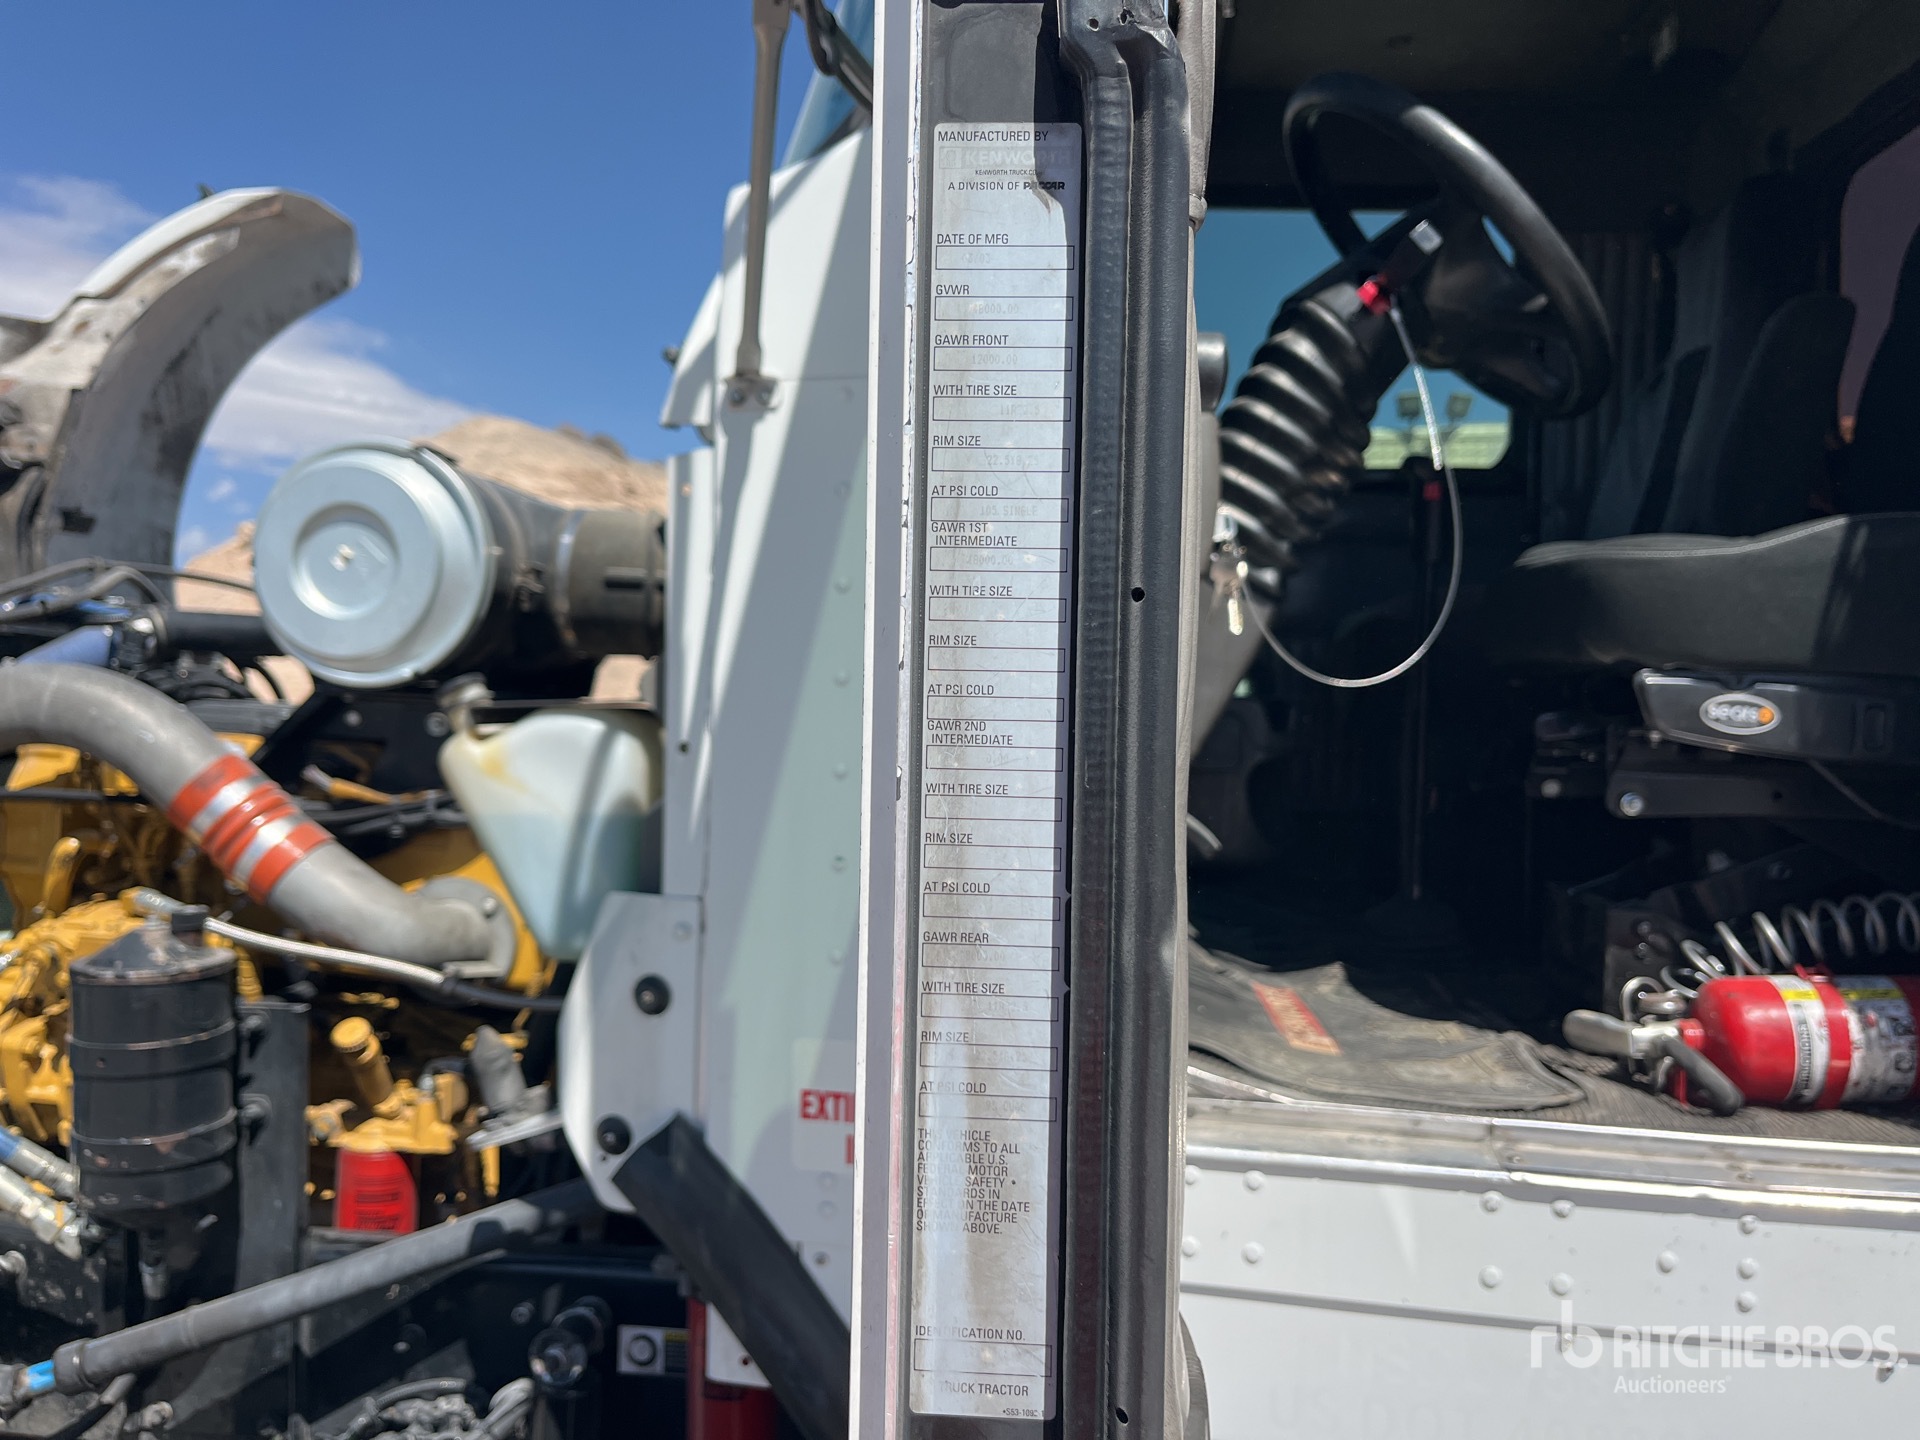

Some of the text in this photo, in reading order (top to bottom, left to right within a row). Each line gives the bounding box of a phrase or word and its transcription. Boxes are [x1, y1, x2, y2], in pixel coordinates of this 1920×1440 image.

[938, 131, 1049, 142] MANUFACTURED BY
[948, 182, 955, 190] A
[958, 182, 1004, 190] DIVISION
[1007, 182, 1020, 190] OF
[937, 234, 1009, 244] DATE OF MFG
[936, 284, 970, 295] GVWR
[934, 335, 1009, 345] GAWR FRONT
[934, 385, 1017, 395] WITH TIRE SIZE
[933, 436, 981, 446] RIM SIZE
[931, 486, 998, 496] AT PSI COLD
[931, 522, 988, 533] GAWR 1ST
[935, 536, 1017, 546] INTERMEDIATE
[929, 585, 1013, 596] WITH TIRE SIZE
[929, 635, 977, 646] RIM SIZE
[927, 684, 994, 695] AT PSI COLD
[927, 720, 986, 731] GAWR 2ND
[931, 734, 1013, 745] INTERMEDIATE
[926, 783, 1008, 795] WITH TIRE SIZE
[925, 833, 973, 843] RIM SIZE
[924, 881, 990, 893] AT PSI COLD
[923, 931, 989, 943] GAWR REAR
[922, 981, 1005, 994] WITH TIRE SIZE
[921, 1031, 969, 1042] RIM SIZE
[920, 1081, 934, 1092] AT
[958, 1082, 987, 1093] COLD
[800, 1088, 856, 1123] EXTI
[946, 1129, 991, 1141] HICLE
[918, 1140, 1020, 1154] COFORMS TO ALL
[987, 1154, 1008, 1165] U.S.
[968, 1165, 1008, 1176] MOTOR
[965, 1177, 1005, 1188] SAFETY
[988, 1188, 1000, 1199] IN
[977, 1200, 998, 1211] THE
[1001, 1201, 1030, 1212] DATE
[962, 1222, 1003, 1234] ABOVE.
[1006, 1329, 1026, 1341] NO.
[978, 1384, 1029, 1396] TRACTOR
